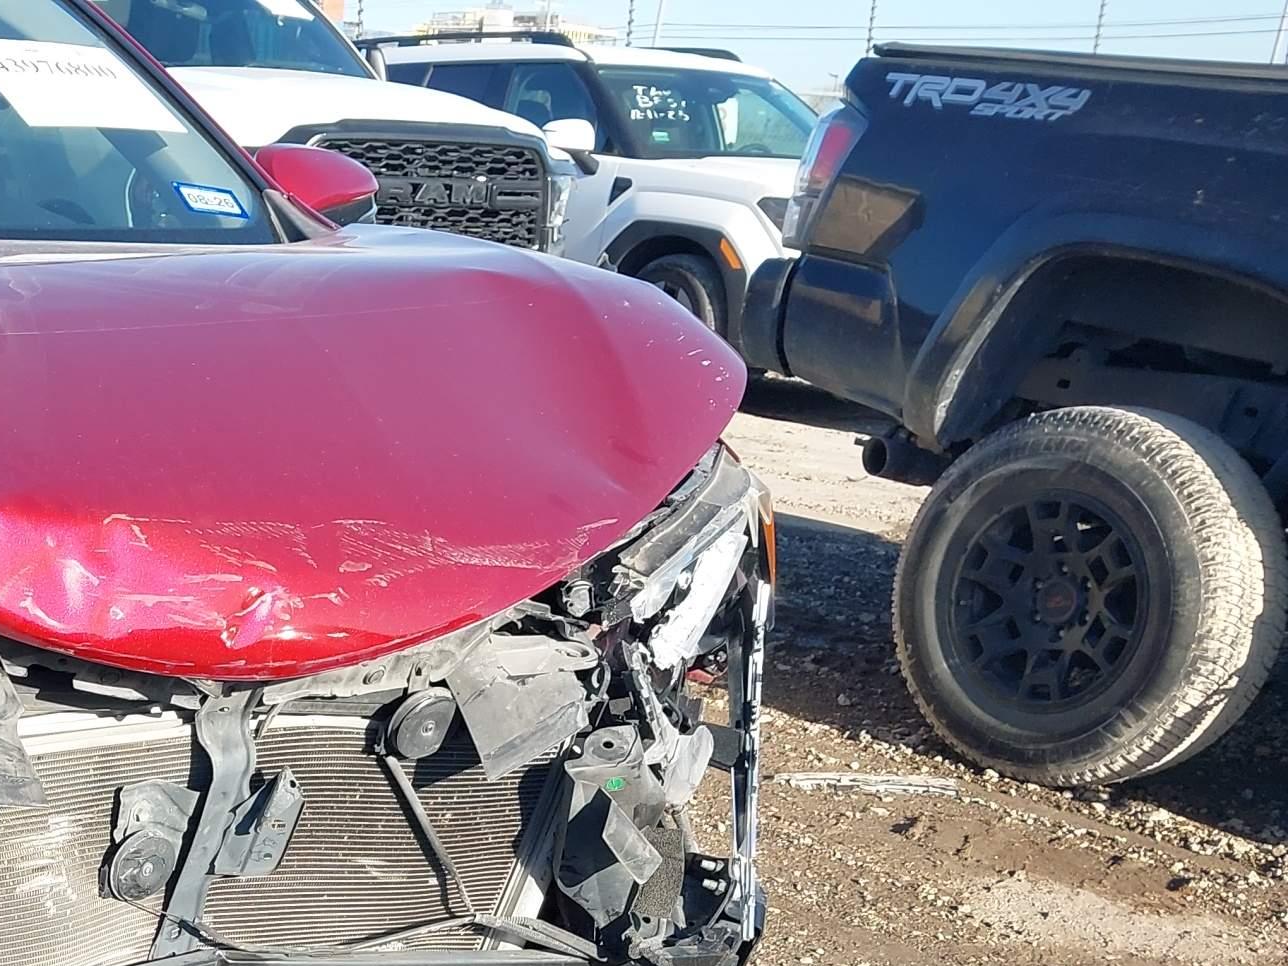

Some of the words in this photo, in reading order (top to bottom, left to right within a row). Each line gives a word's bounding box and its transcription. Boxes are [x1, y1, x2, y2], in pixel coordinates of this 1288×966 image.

[886, 72, 987, 110] TRD
[982, 82, 1092, 116] 4X4
[970, 102, 1065, 122] SPORT
[376, 181, 487, 204] RAM
